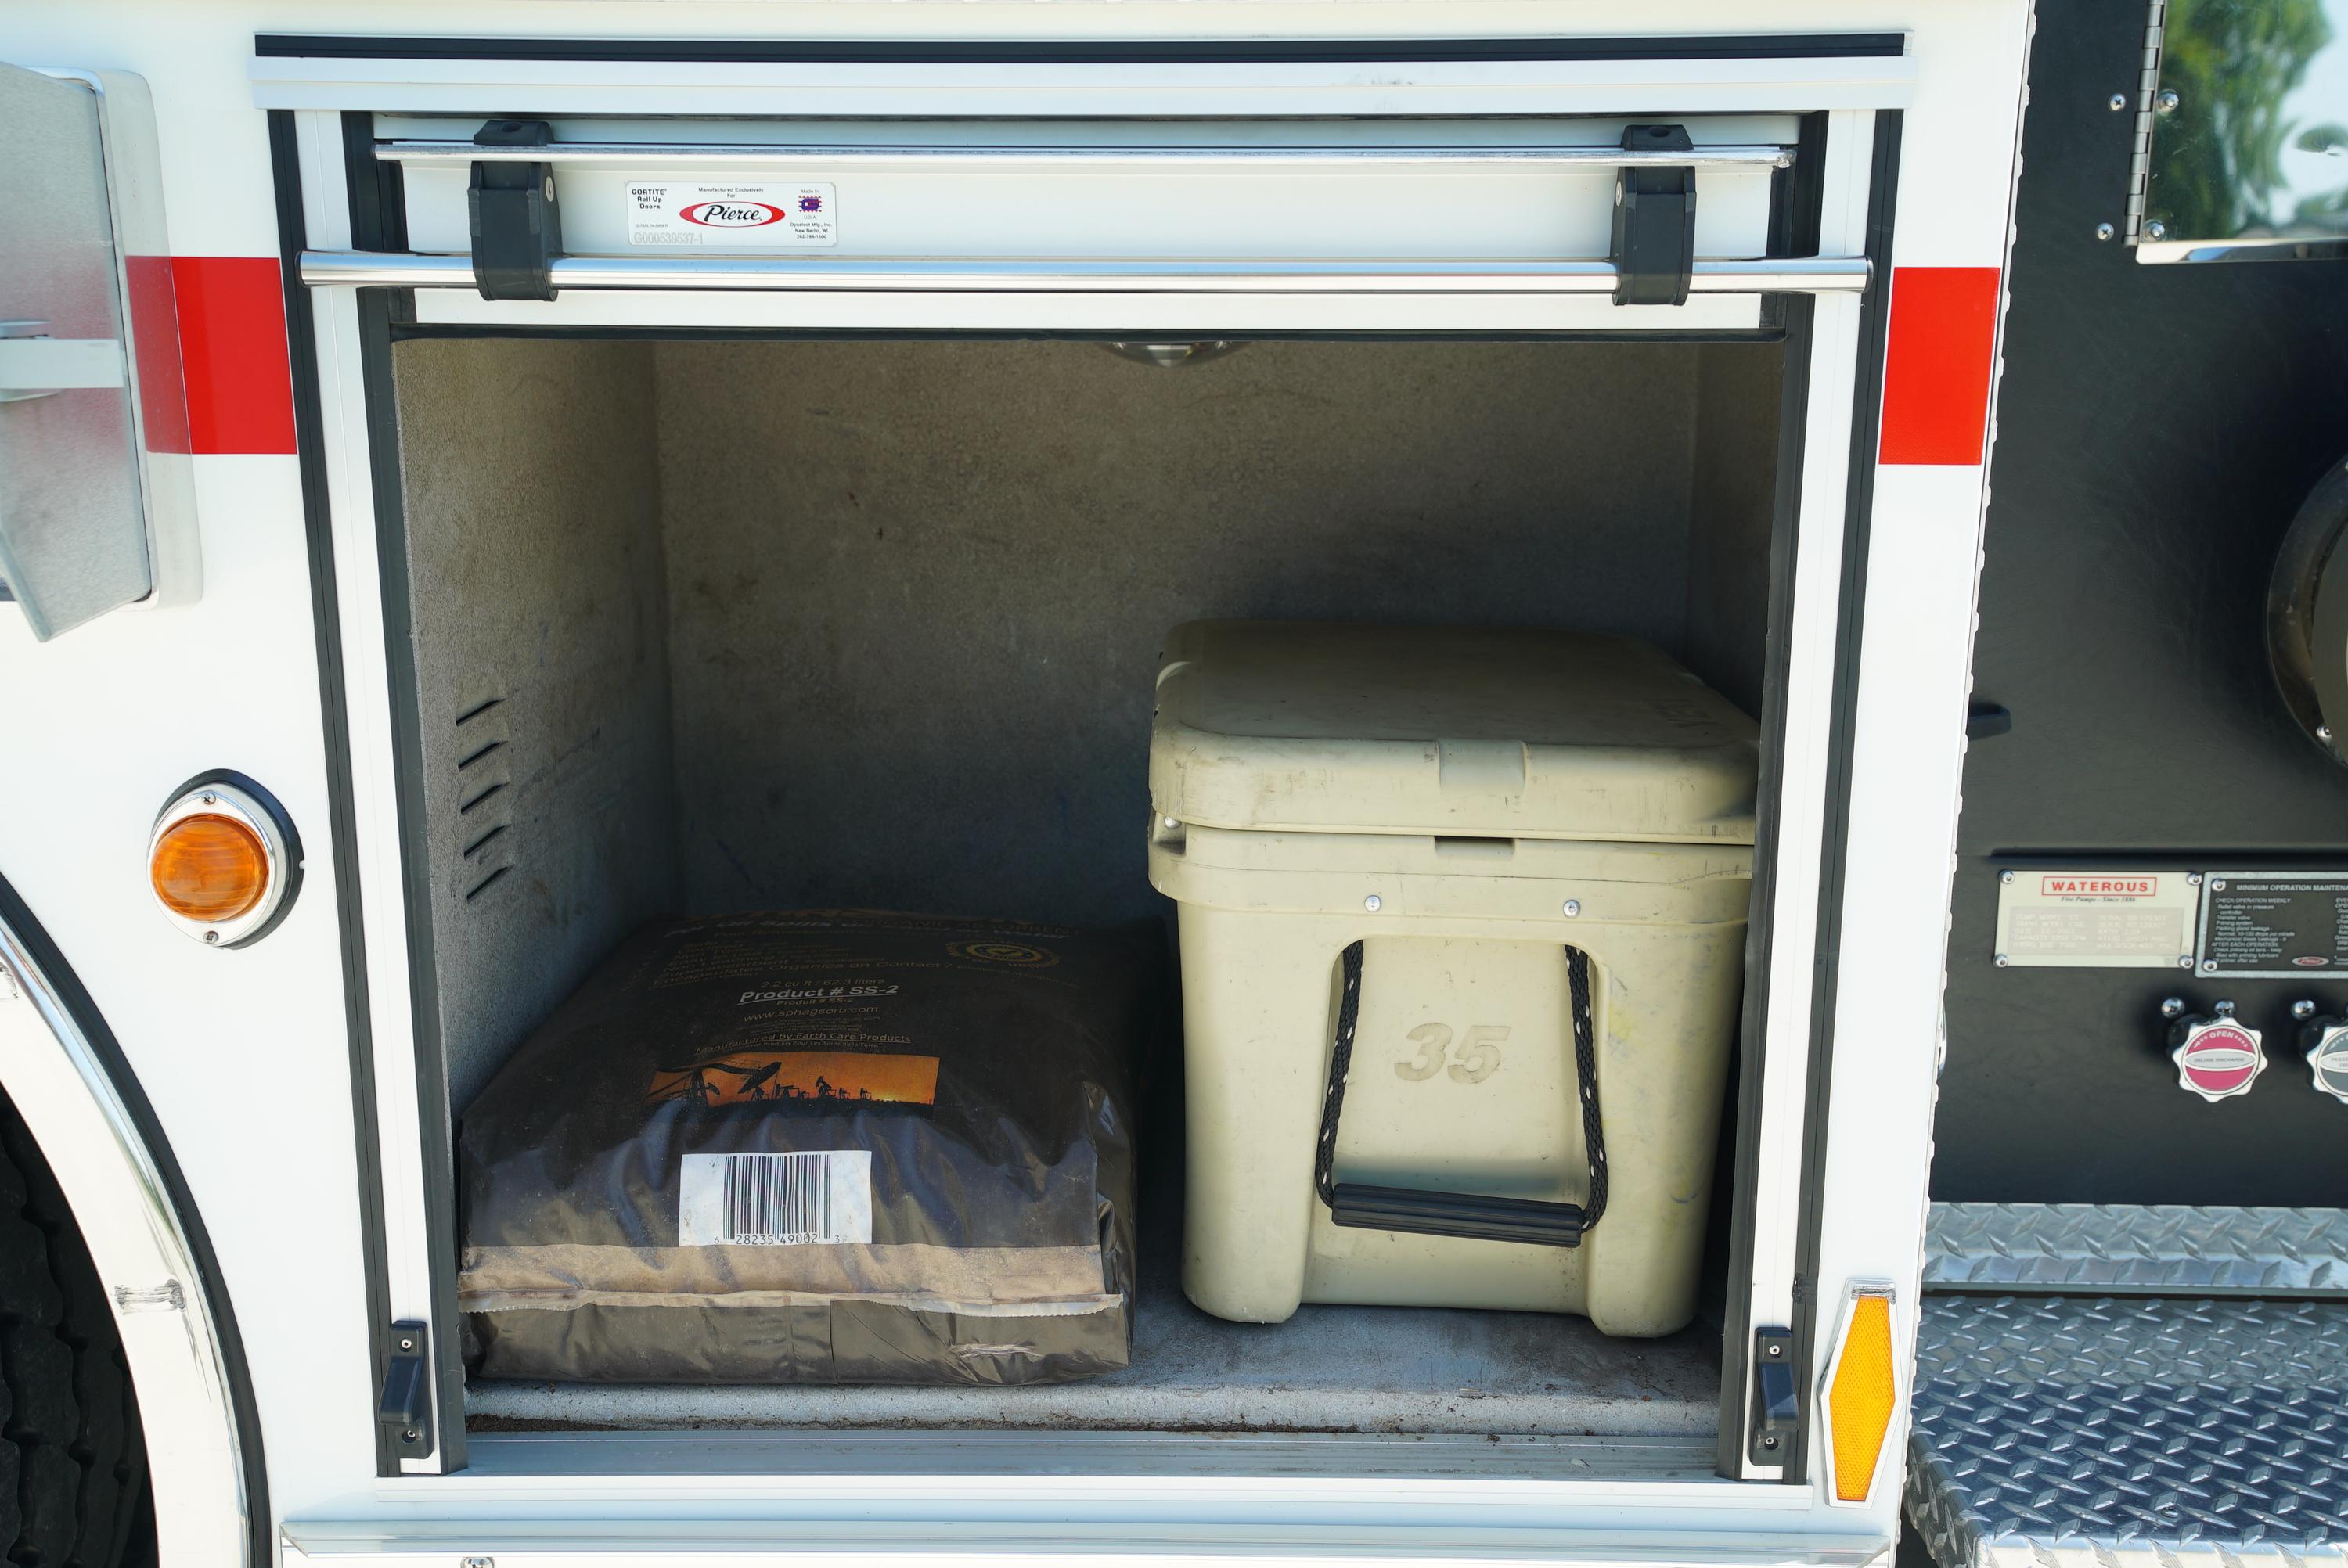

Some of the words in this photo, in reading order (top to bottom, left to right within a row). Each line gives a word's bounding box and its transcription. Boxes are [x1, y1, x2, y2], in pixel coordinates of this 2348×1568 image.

[704, 204, 761, 222] Pierce
[2051, 881, 2148, 892] WATEROUS
[769, 962, 844, 972] Organics
[876, 961, 940, 969] Contact
[740, 987, 824, 1004] Product
[830, 986, 846, 997] #
[849, 984, 900, 995] SS-2
[776, 998, 819, 1006] Produit
[744, 1005, 879, 1023] www.sphagsorb.com
[2209, 1030, 2234, 1039] OPEN
[695, 1034, 776, 1054] Manufactured
[779, 1032, 793, 1041] by
[796, 1032, 826, 1041] Earth
[830, 1033, 857, 1041] Care
[860, 1033, 912, 1043] Products
[1393, 1022, 1512, 1085] 35
[714, 1235, 720, 1245] 6
[736, 1234, 774, 1246] 28235
[780, 1233, 818, 1245] 49002
[834, 1235, 840, 1244] 3
